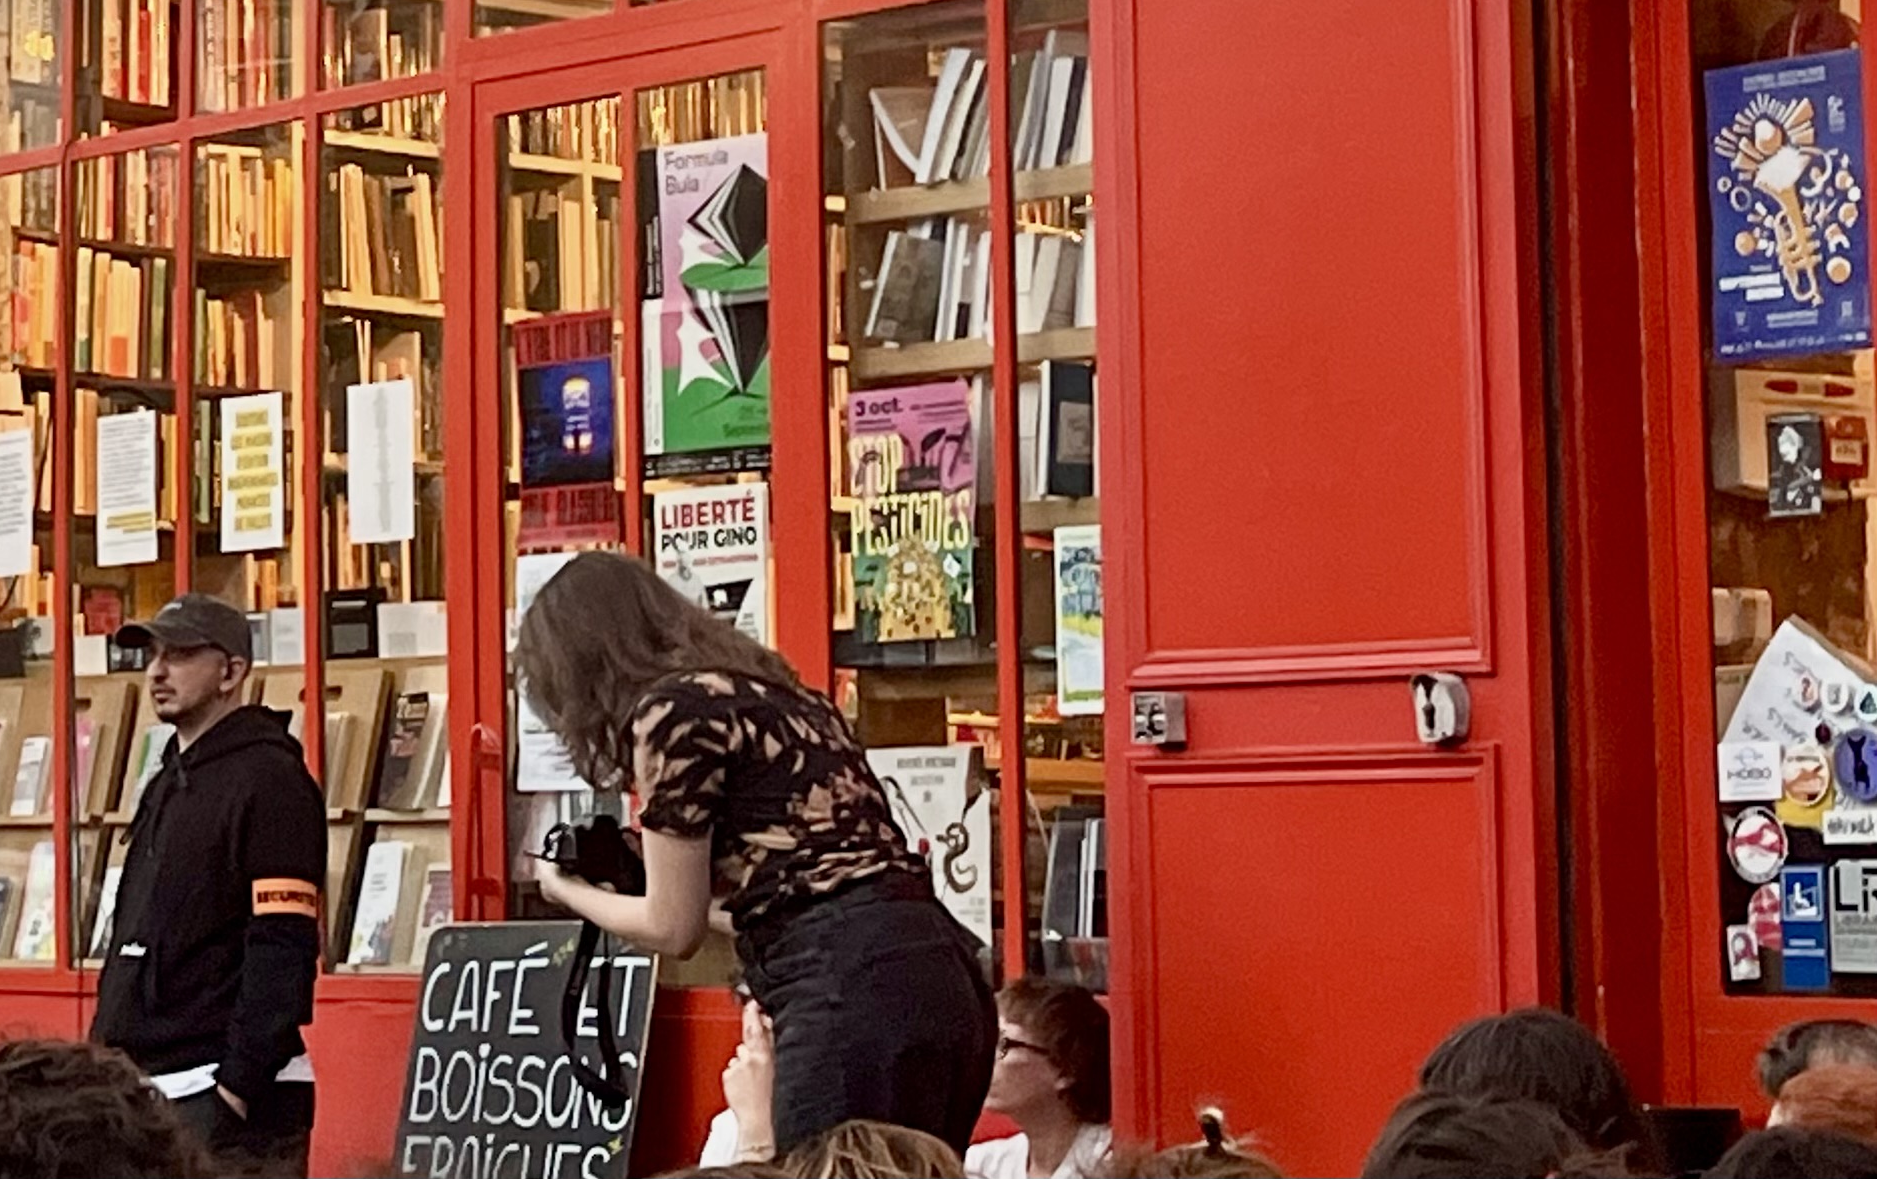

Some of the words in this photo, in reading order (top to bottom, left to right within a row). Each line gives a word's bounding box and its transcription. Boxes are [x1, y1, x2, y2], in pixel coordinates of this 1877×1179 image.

[663, 144, 729, 171] Formula
[855, 400, 866, 417] 3
[661, 489, 756, 530] LIBERTÉ
[661, 529, 709, 553] POUR
[713, 526, 758, 548] GINO
[421, 941, 550, 1035] CAFÉ
[576, 956, 652, 1037] ET
